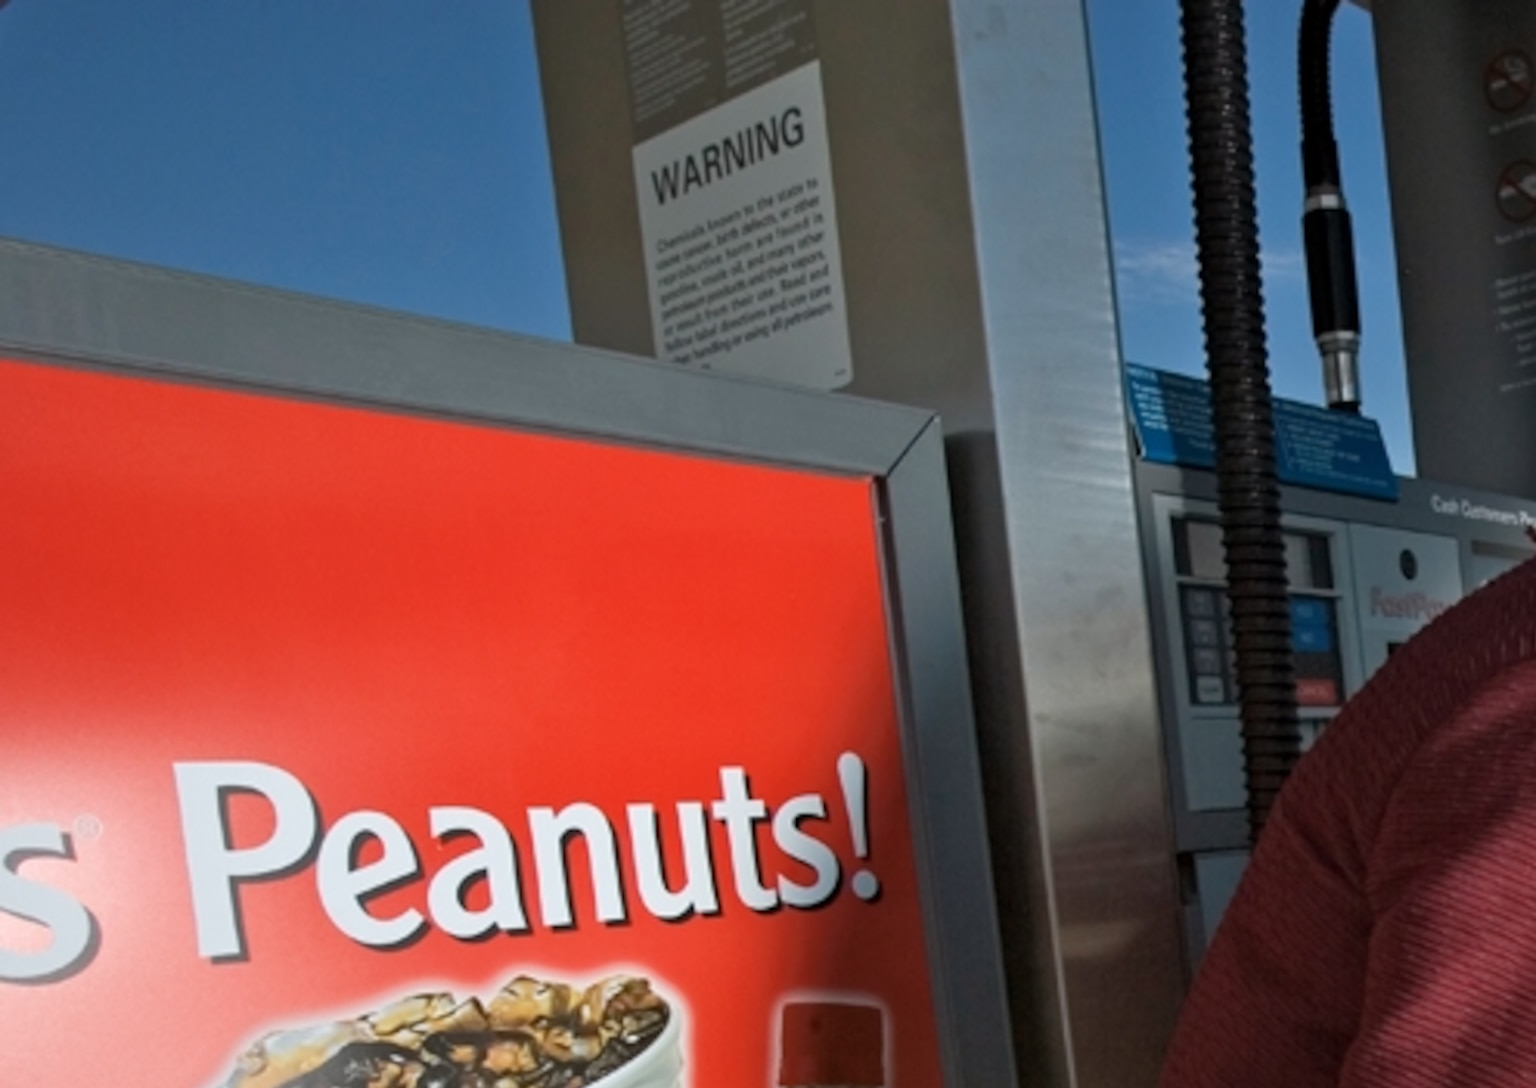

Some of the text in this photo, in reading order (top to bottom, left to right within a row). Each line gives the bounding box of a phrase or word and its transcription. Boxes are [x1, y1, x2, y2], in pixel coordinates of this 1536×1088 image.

[651, 107, 805, 205] WARNING
[656, 225, 705, 253] Chemicals
[708, 211, 741, 231] known
[756, 195, 774, 211] the
[794, 195, 820, 214] other
[658, 253, 723, 287] reproductive
[726, 241, 753, 259] harm
[776, 217, 810, 239] found
[747, 254, 765, 270] and
[797, 231, 824, 250] other
[705, 304, 728, 321] from
[731, 295, 754, 311] their
[780, 275, 806, 292] Read
[810, 264, 829, 281] and
[173, 751, 878, 964] Peanuts!
